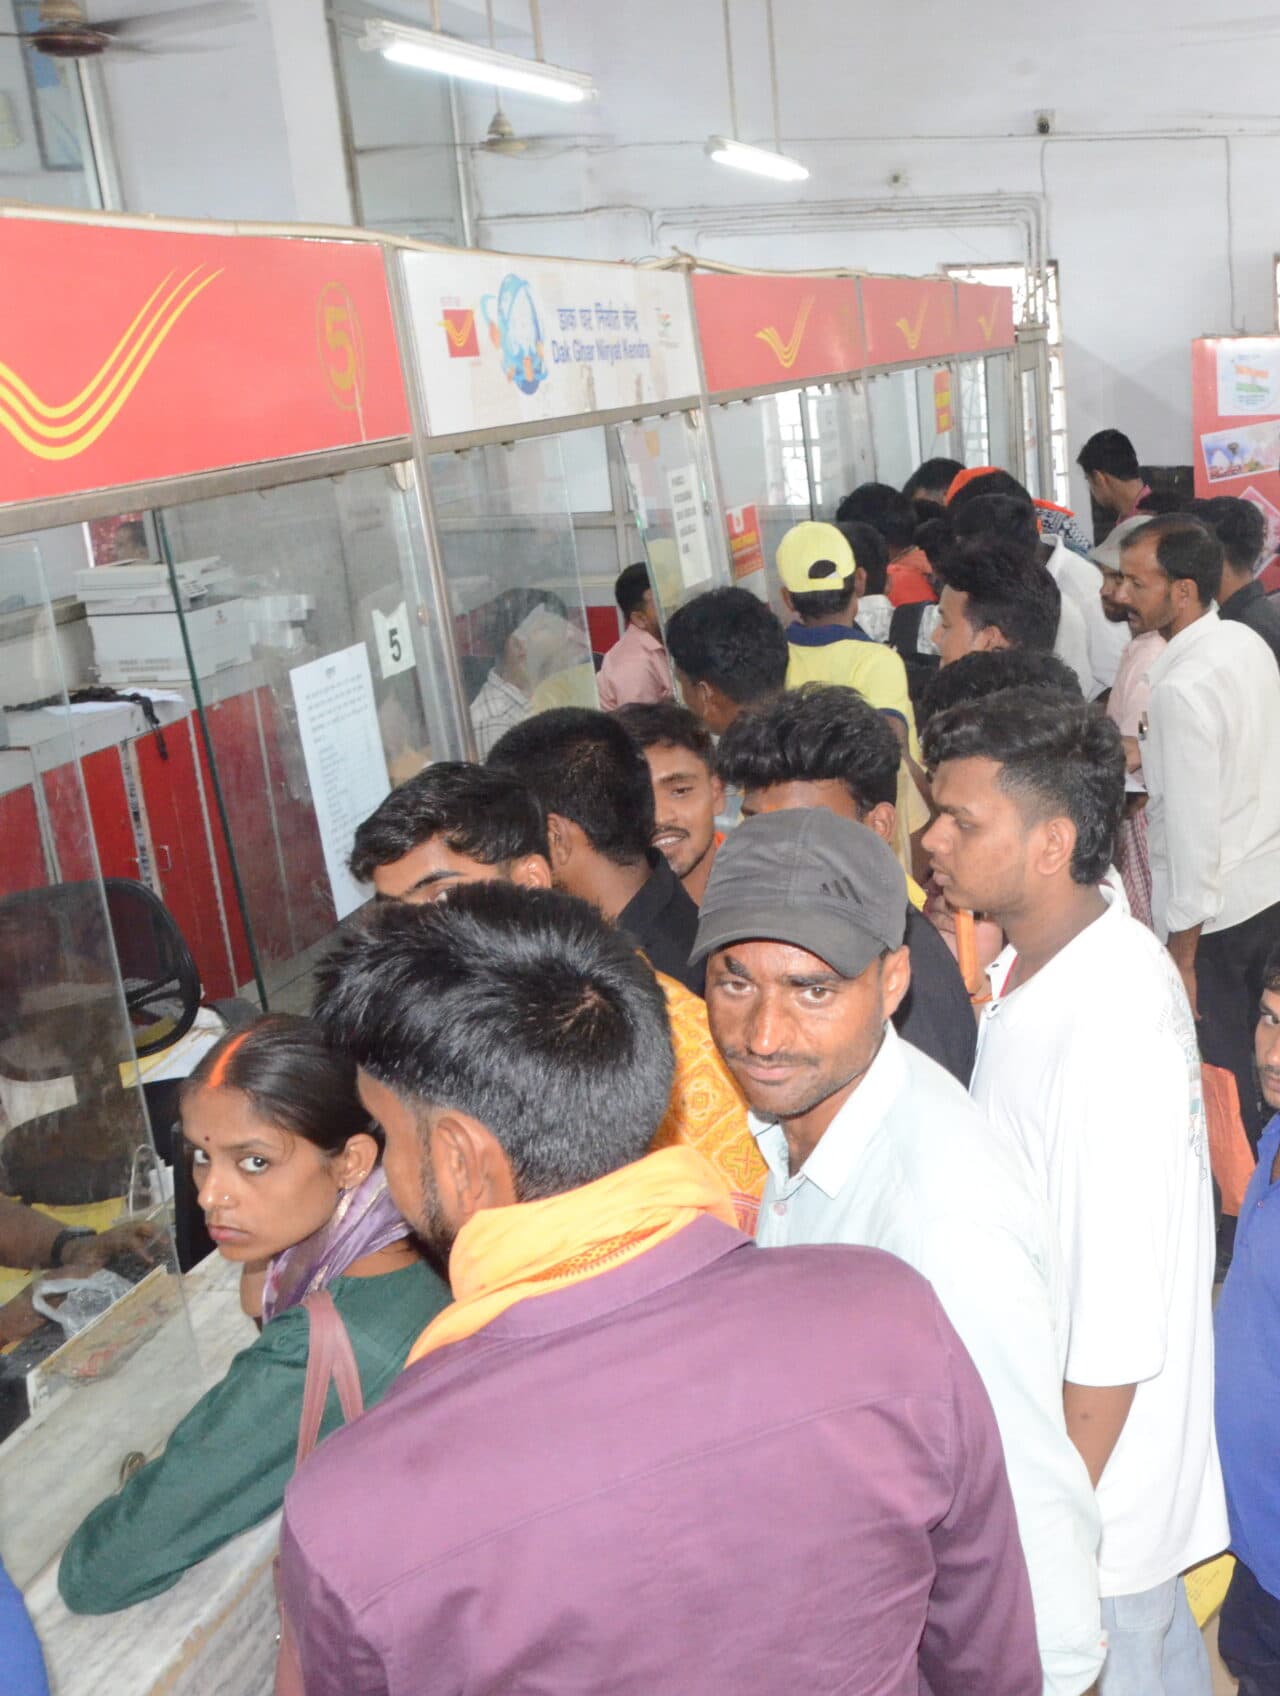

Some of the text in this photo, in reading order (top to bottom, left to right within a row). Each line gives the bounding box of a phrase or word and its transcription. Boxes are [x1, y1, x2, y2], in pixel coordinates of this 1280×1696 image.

[324, 305, 357, 391] 5
[551, 339, 572, 363] Dak
[573, 338, 595, 362] Ghar
[387, 628, 402, 663] 5
